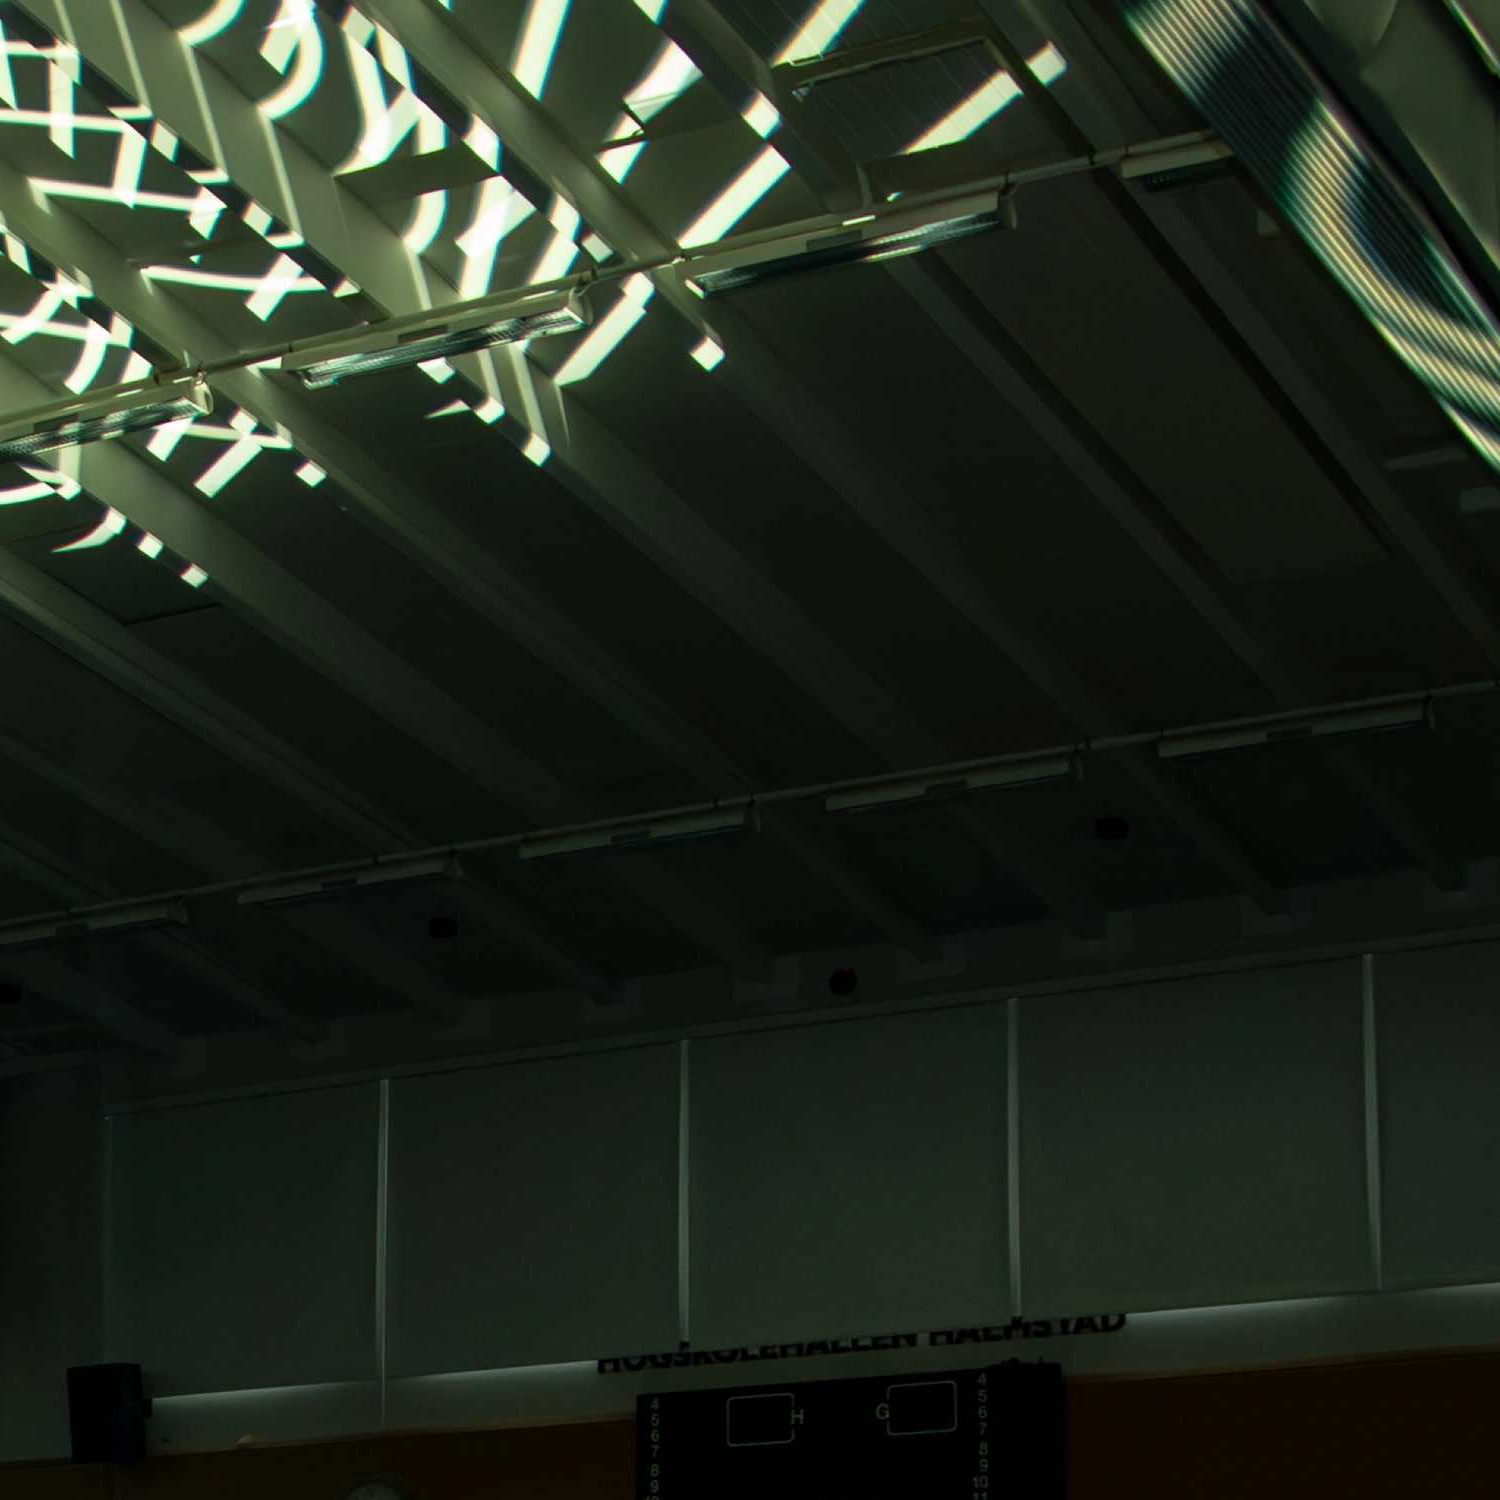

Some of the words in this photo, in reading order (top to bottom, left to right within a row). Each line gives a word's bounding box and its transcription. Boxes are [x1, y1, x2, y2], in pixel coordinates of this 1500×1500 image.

[977, 1372, 987, 1386] 4
[977, 1389, 988, 1402] 5
[650, 1397, 660, 1411] 4
[874, 1403, 891, 1421] G
[977, 1405, 988, 1419] 6
[651, 1413, 660, 1427] 5
[650, 1428, 660, 1443] 6
[978, 1422, 988, 1436] 7
[650, 1444, 659, 1458] 7
[978, 1442, 989, 1456] 8
[650, 1463, 660, 1477] 8
[978, 1458, 989, 1472] 9
[650, 1479, 660, 1493] 9
[972, 1475, 989, 1489] 10
